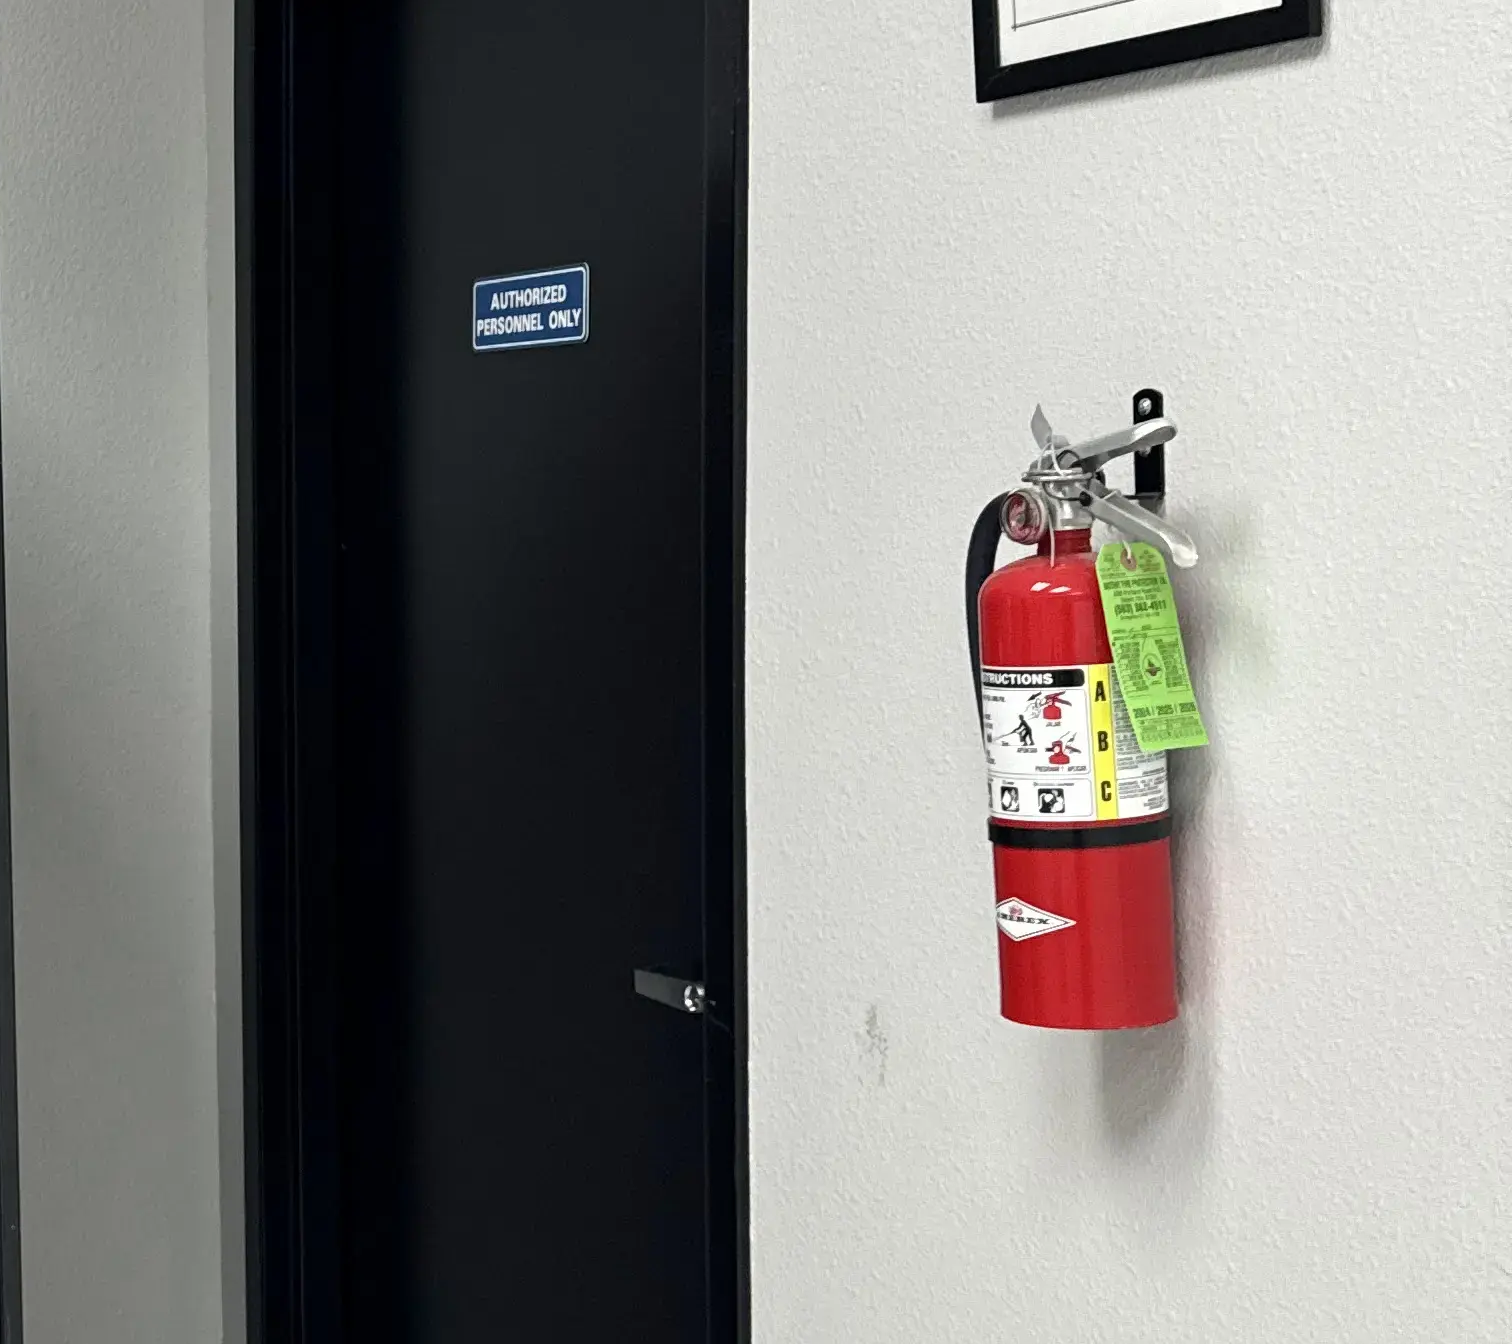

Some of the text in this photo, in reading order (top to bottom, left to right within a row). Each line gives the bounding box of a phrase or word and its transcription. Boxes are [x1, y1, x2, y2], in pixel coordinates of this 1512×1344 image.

[490, 284, 567, 311] AUTHORIZED
[477, 307, 582, 337] PERSONNEL ONLY
[1094, 681, 1106, 702] A
[1097, 731, 1109, 752] B
[1101, 780, 1112, 802] C
